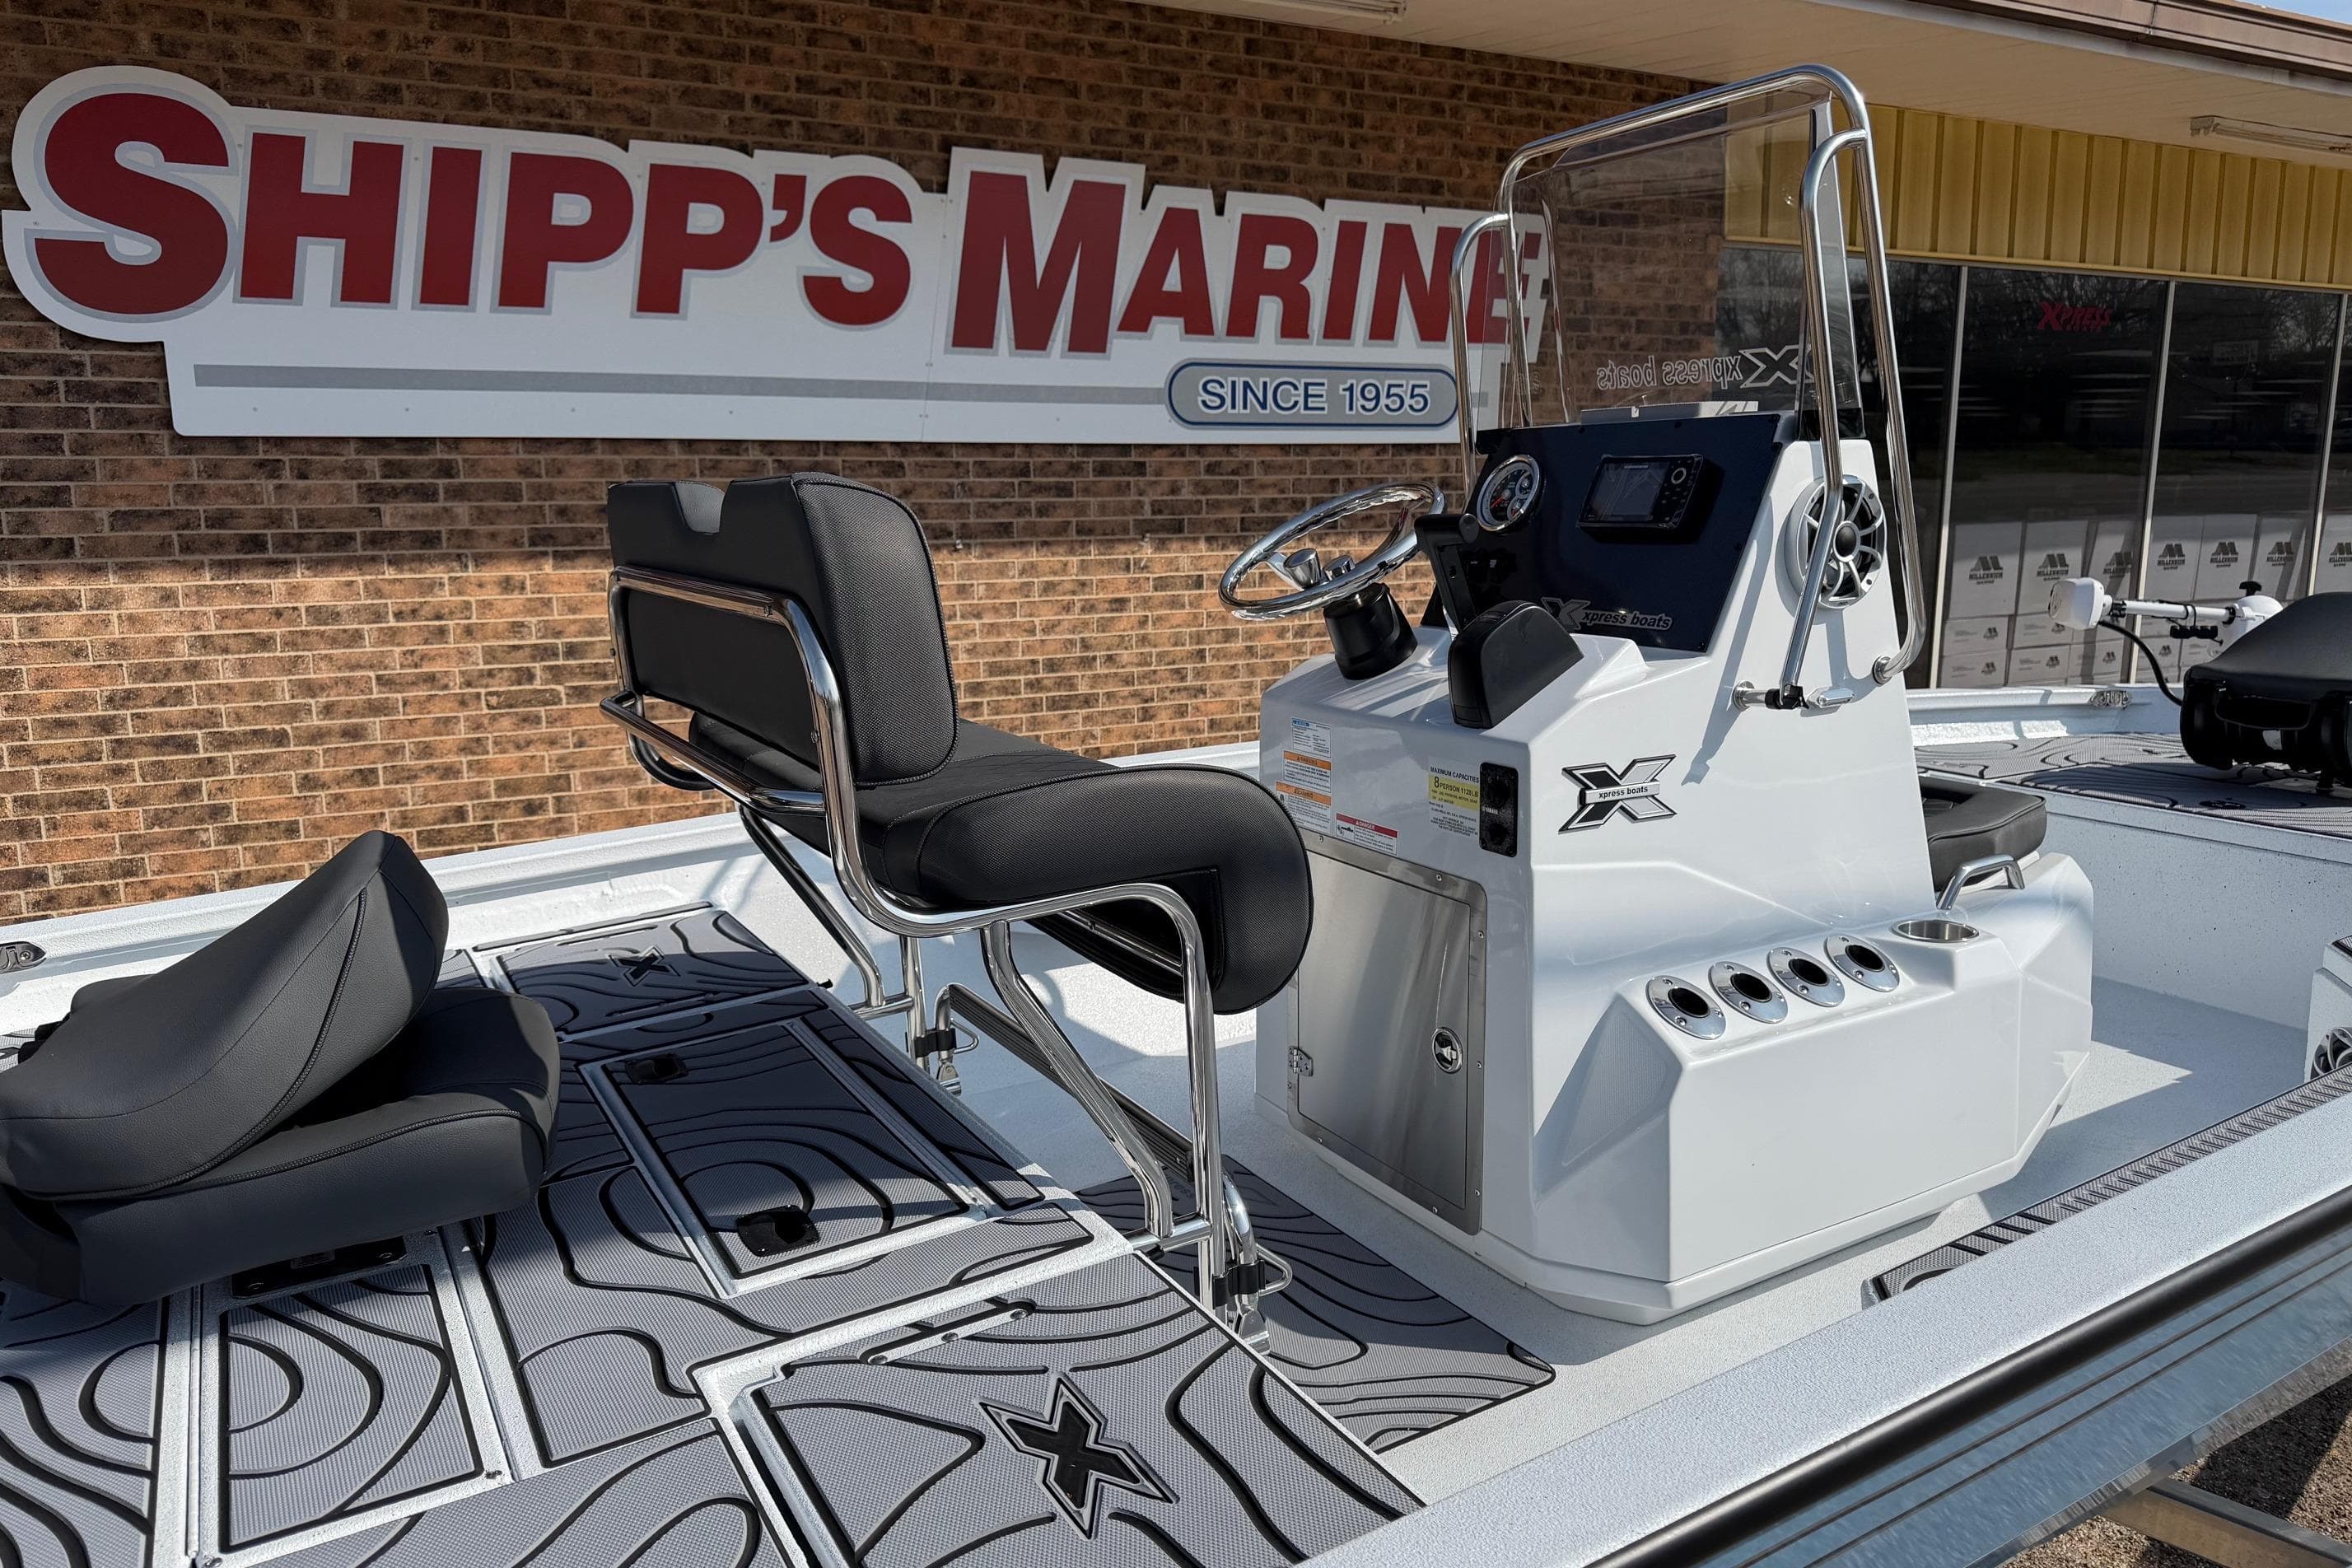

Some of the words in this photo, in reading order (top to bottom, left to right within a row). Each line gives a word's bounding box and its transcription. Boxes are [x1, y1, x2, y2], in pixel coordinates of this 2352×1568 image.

[1200, 378, 1327, 413] SINCE
[1341, 380, 1430, 413] 1955
[1581, 610, 1628, 625] xpress
[1630, 610, 1671, 628] boats
[1430, 767, 1452, 777] MAXIMUM
[1453, 772, 1479, 783] CAPACITIES
[1434, 777, 1440, 788] 8
[1440, 782, 1460, 793] PERSON
[1598, 788, 1625, 800] xpress
[1626, 786, 1648, 796] boats
